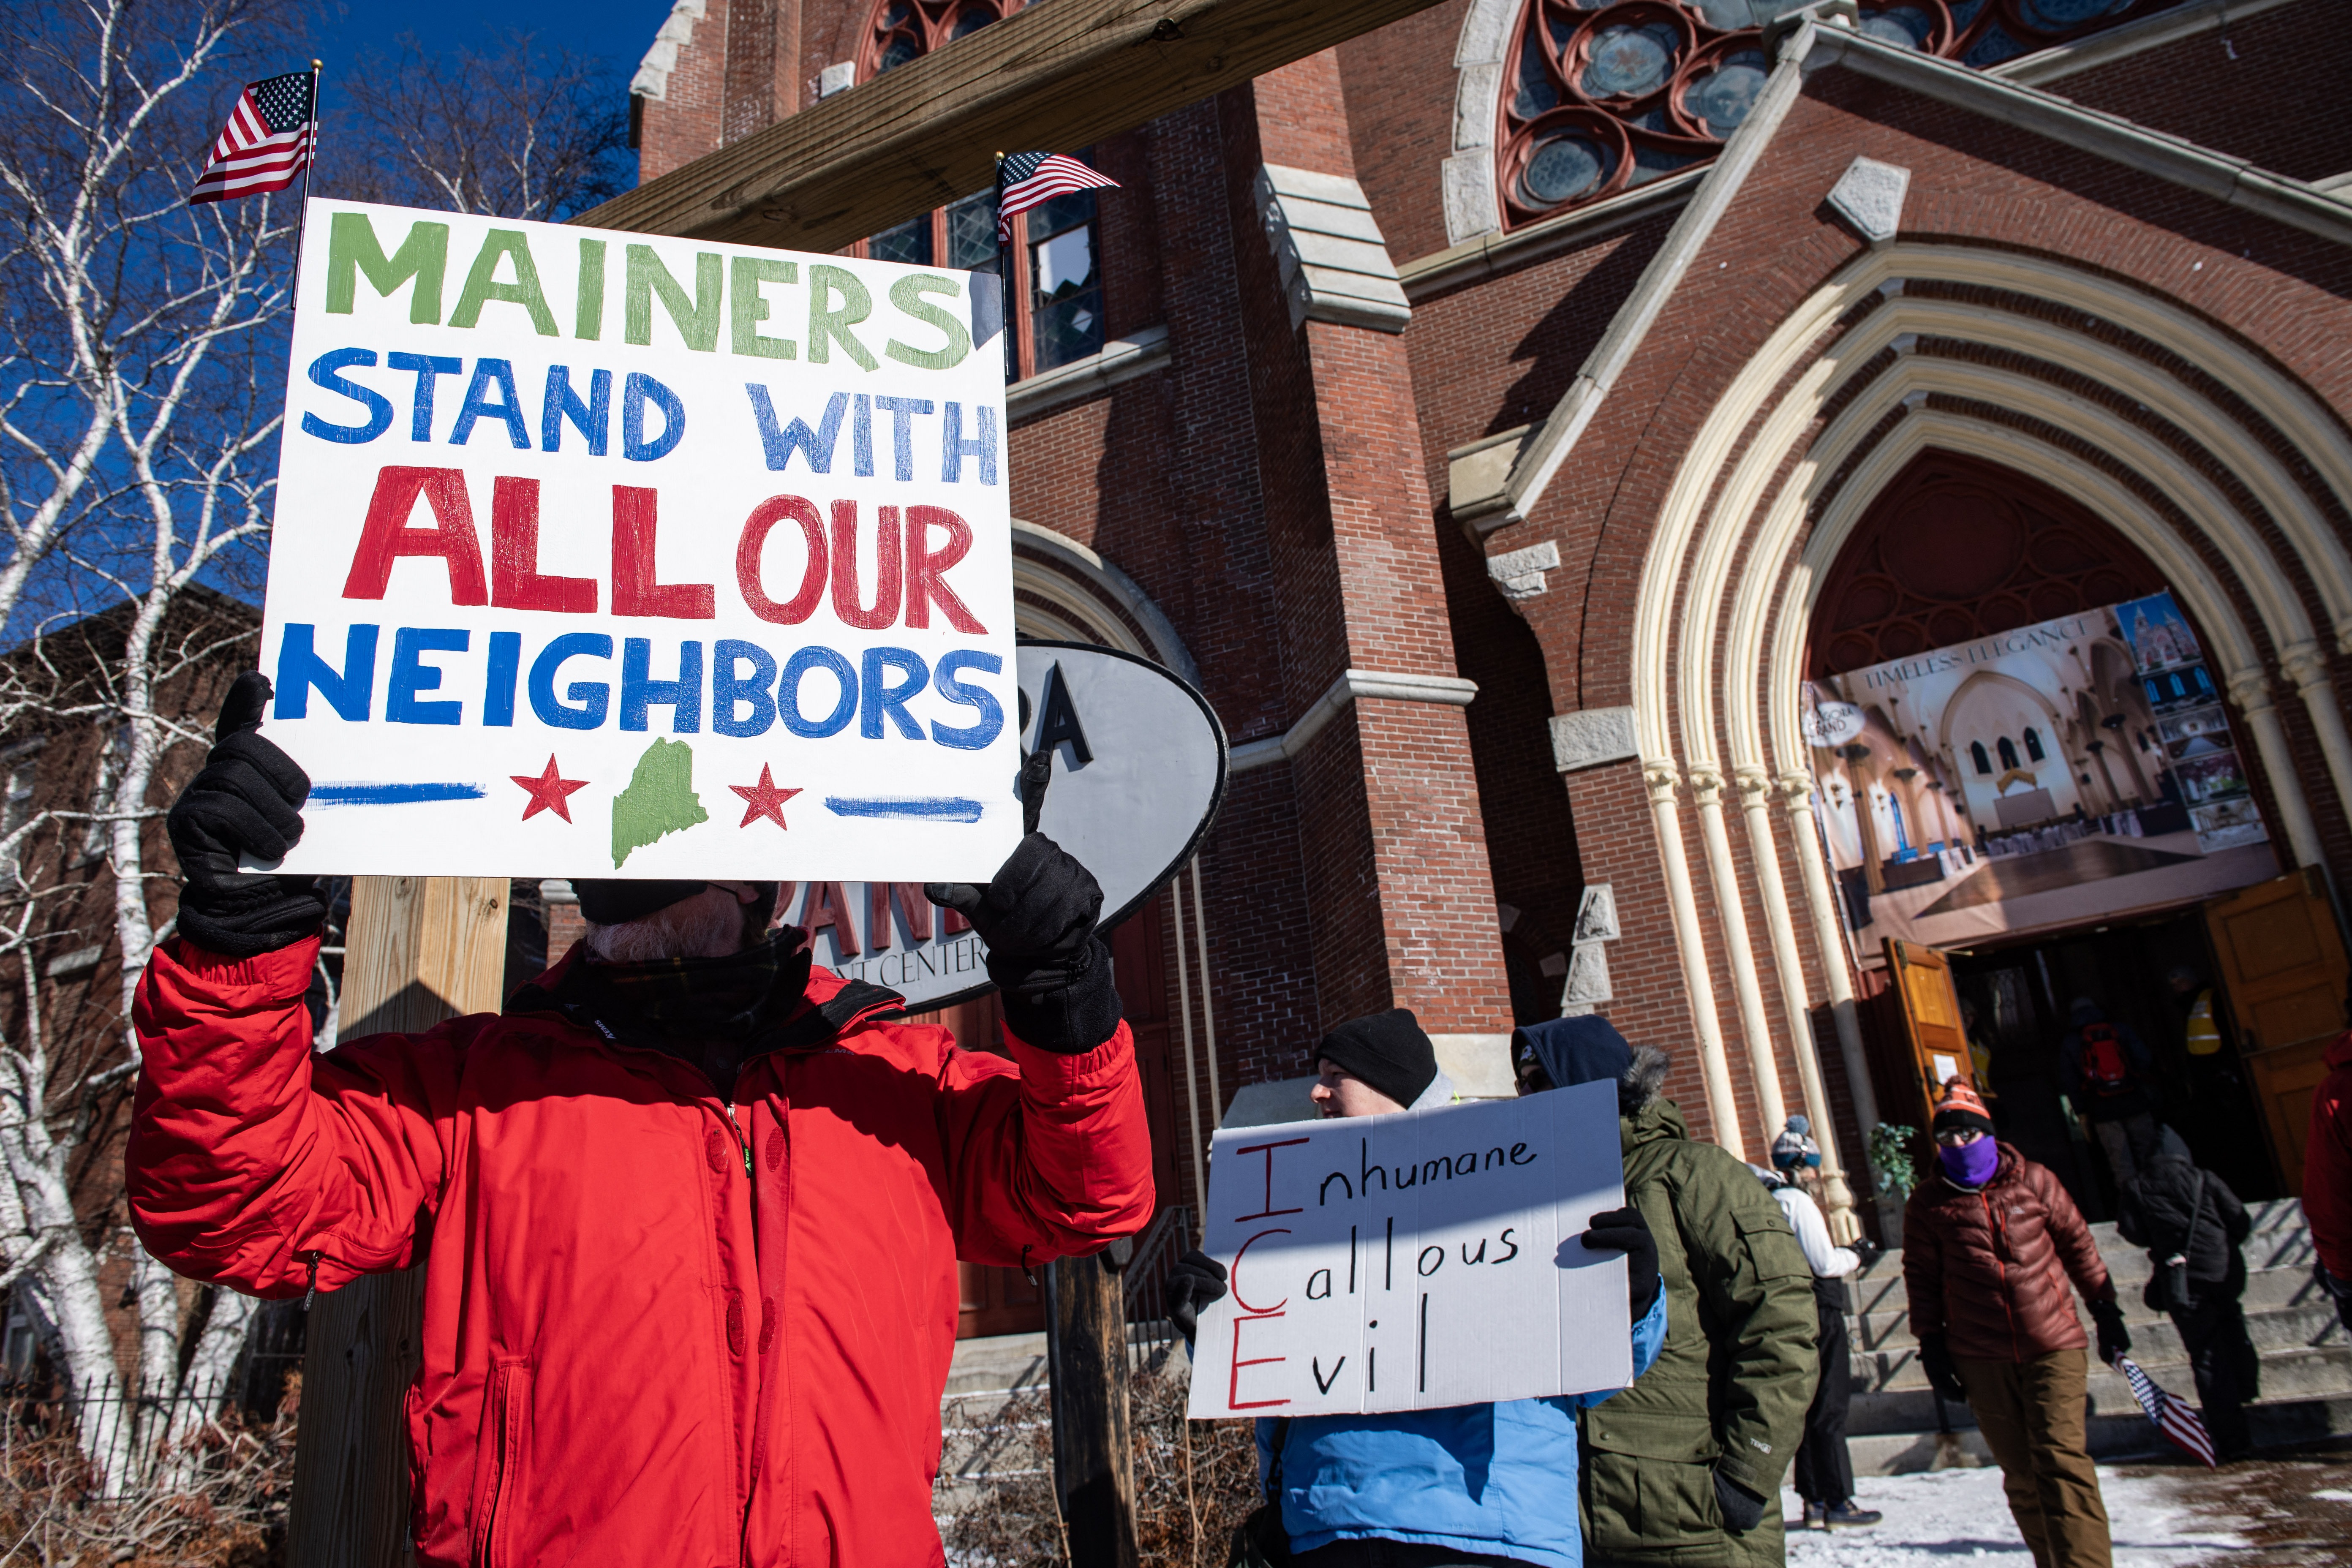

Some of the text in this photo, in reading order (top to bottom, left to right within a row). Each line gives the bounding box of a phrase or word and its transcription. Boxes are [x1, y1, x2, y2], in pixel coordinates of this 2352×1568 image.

[326, 212, 971, 371] MAINERS
[301, 347, 998, 485] STAND WITH
[342, 466, 988, 634] ALL OUR
[273, 623, 1004, 751] NEIGHBORS
[1863, 618, 2094, 689] TIMELESS ELEGANCE
[880, 936, 987, 988] CENTER
[1234, 1137, 1538, 1222] Inhumane
[1230, 1217, 1519, 1314] Callous
[1228, 1293, 1428, 1410] Evil
